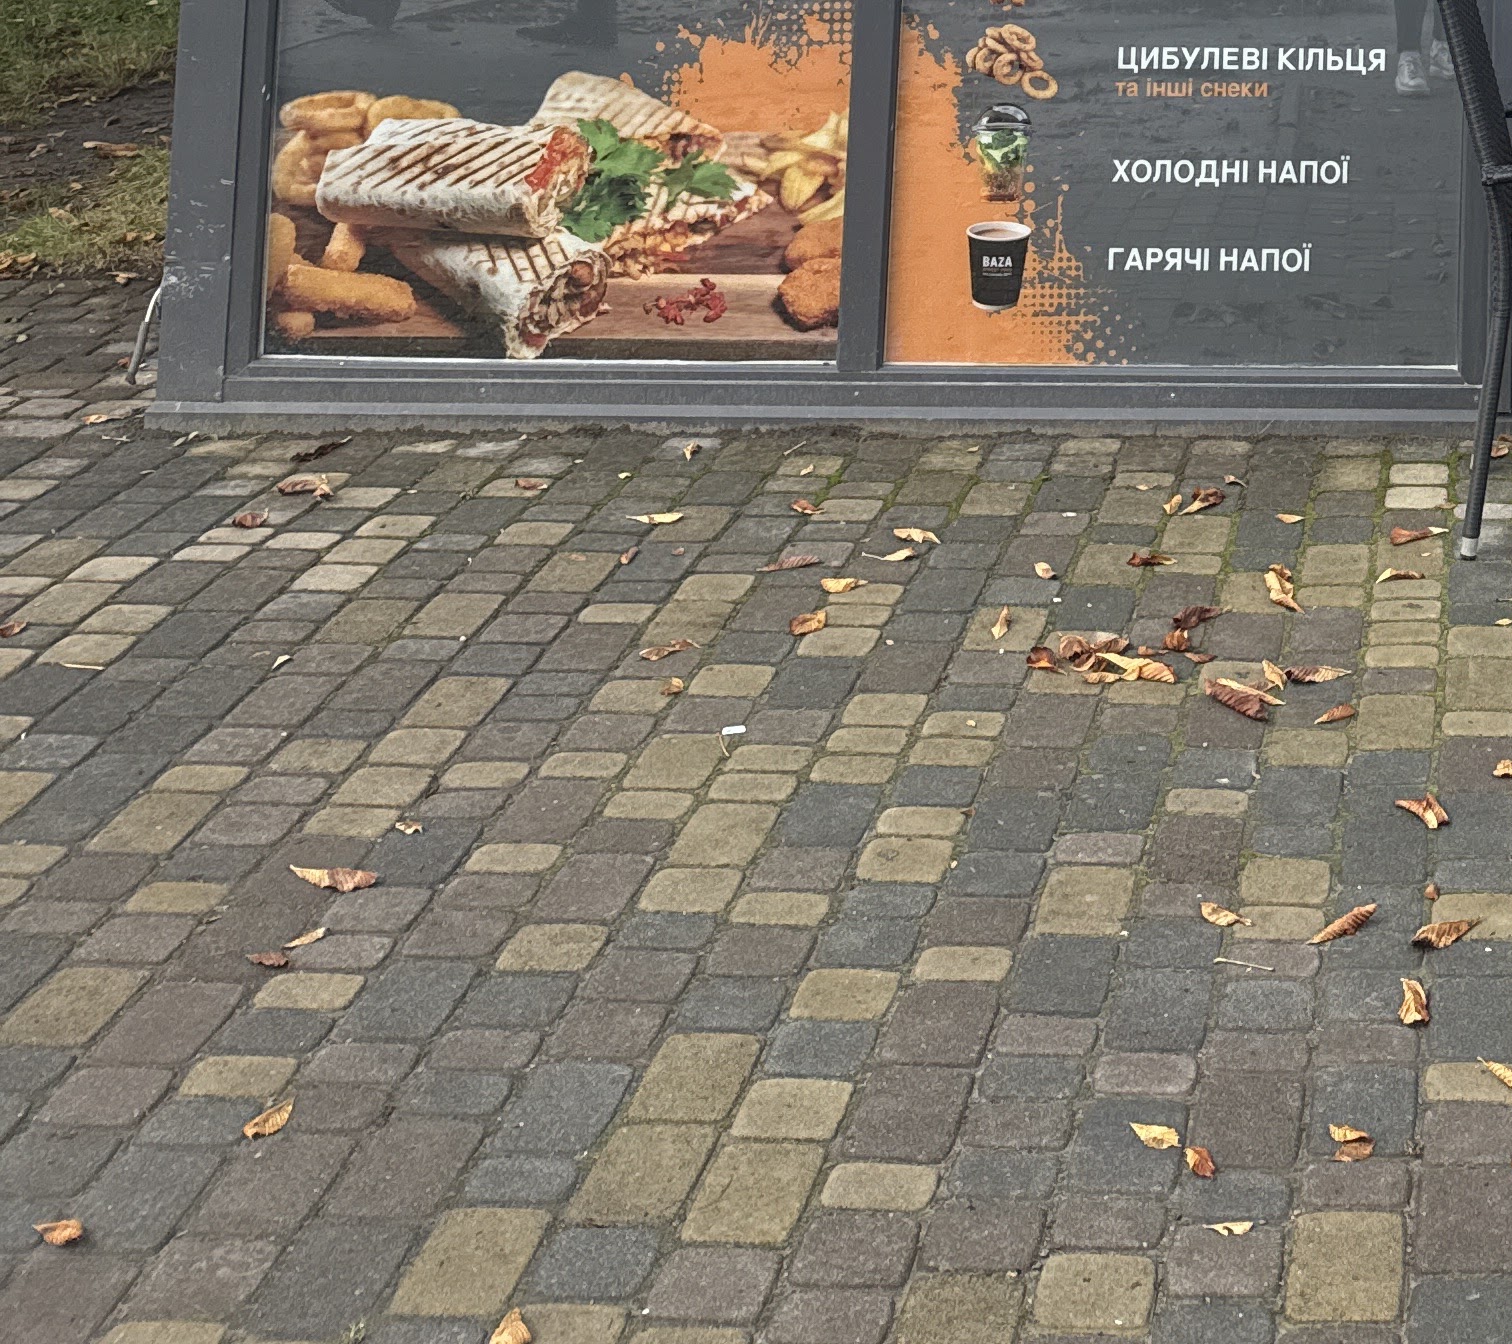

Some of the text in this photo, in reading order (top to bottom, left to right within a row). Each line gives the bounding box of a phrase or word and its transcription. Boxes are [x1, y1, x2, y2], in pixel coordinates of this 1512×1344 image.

[1117, 46, 1387, 76] ЦИБУЛЕВІ КІЛЬЦЯ
[1114, 78, 1270, 98] та інші снеки
[1111, 155, 1351, 187] ХОЛОДНІ НАПОЇ
[982, 255, 1013, 268] BAZA
[1107, 242, 1313, 272] ГАРЯЧІ НАПОЇ
